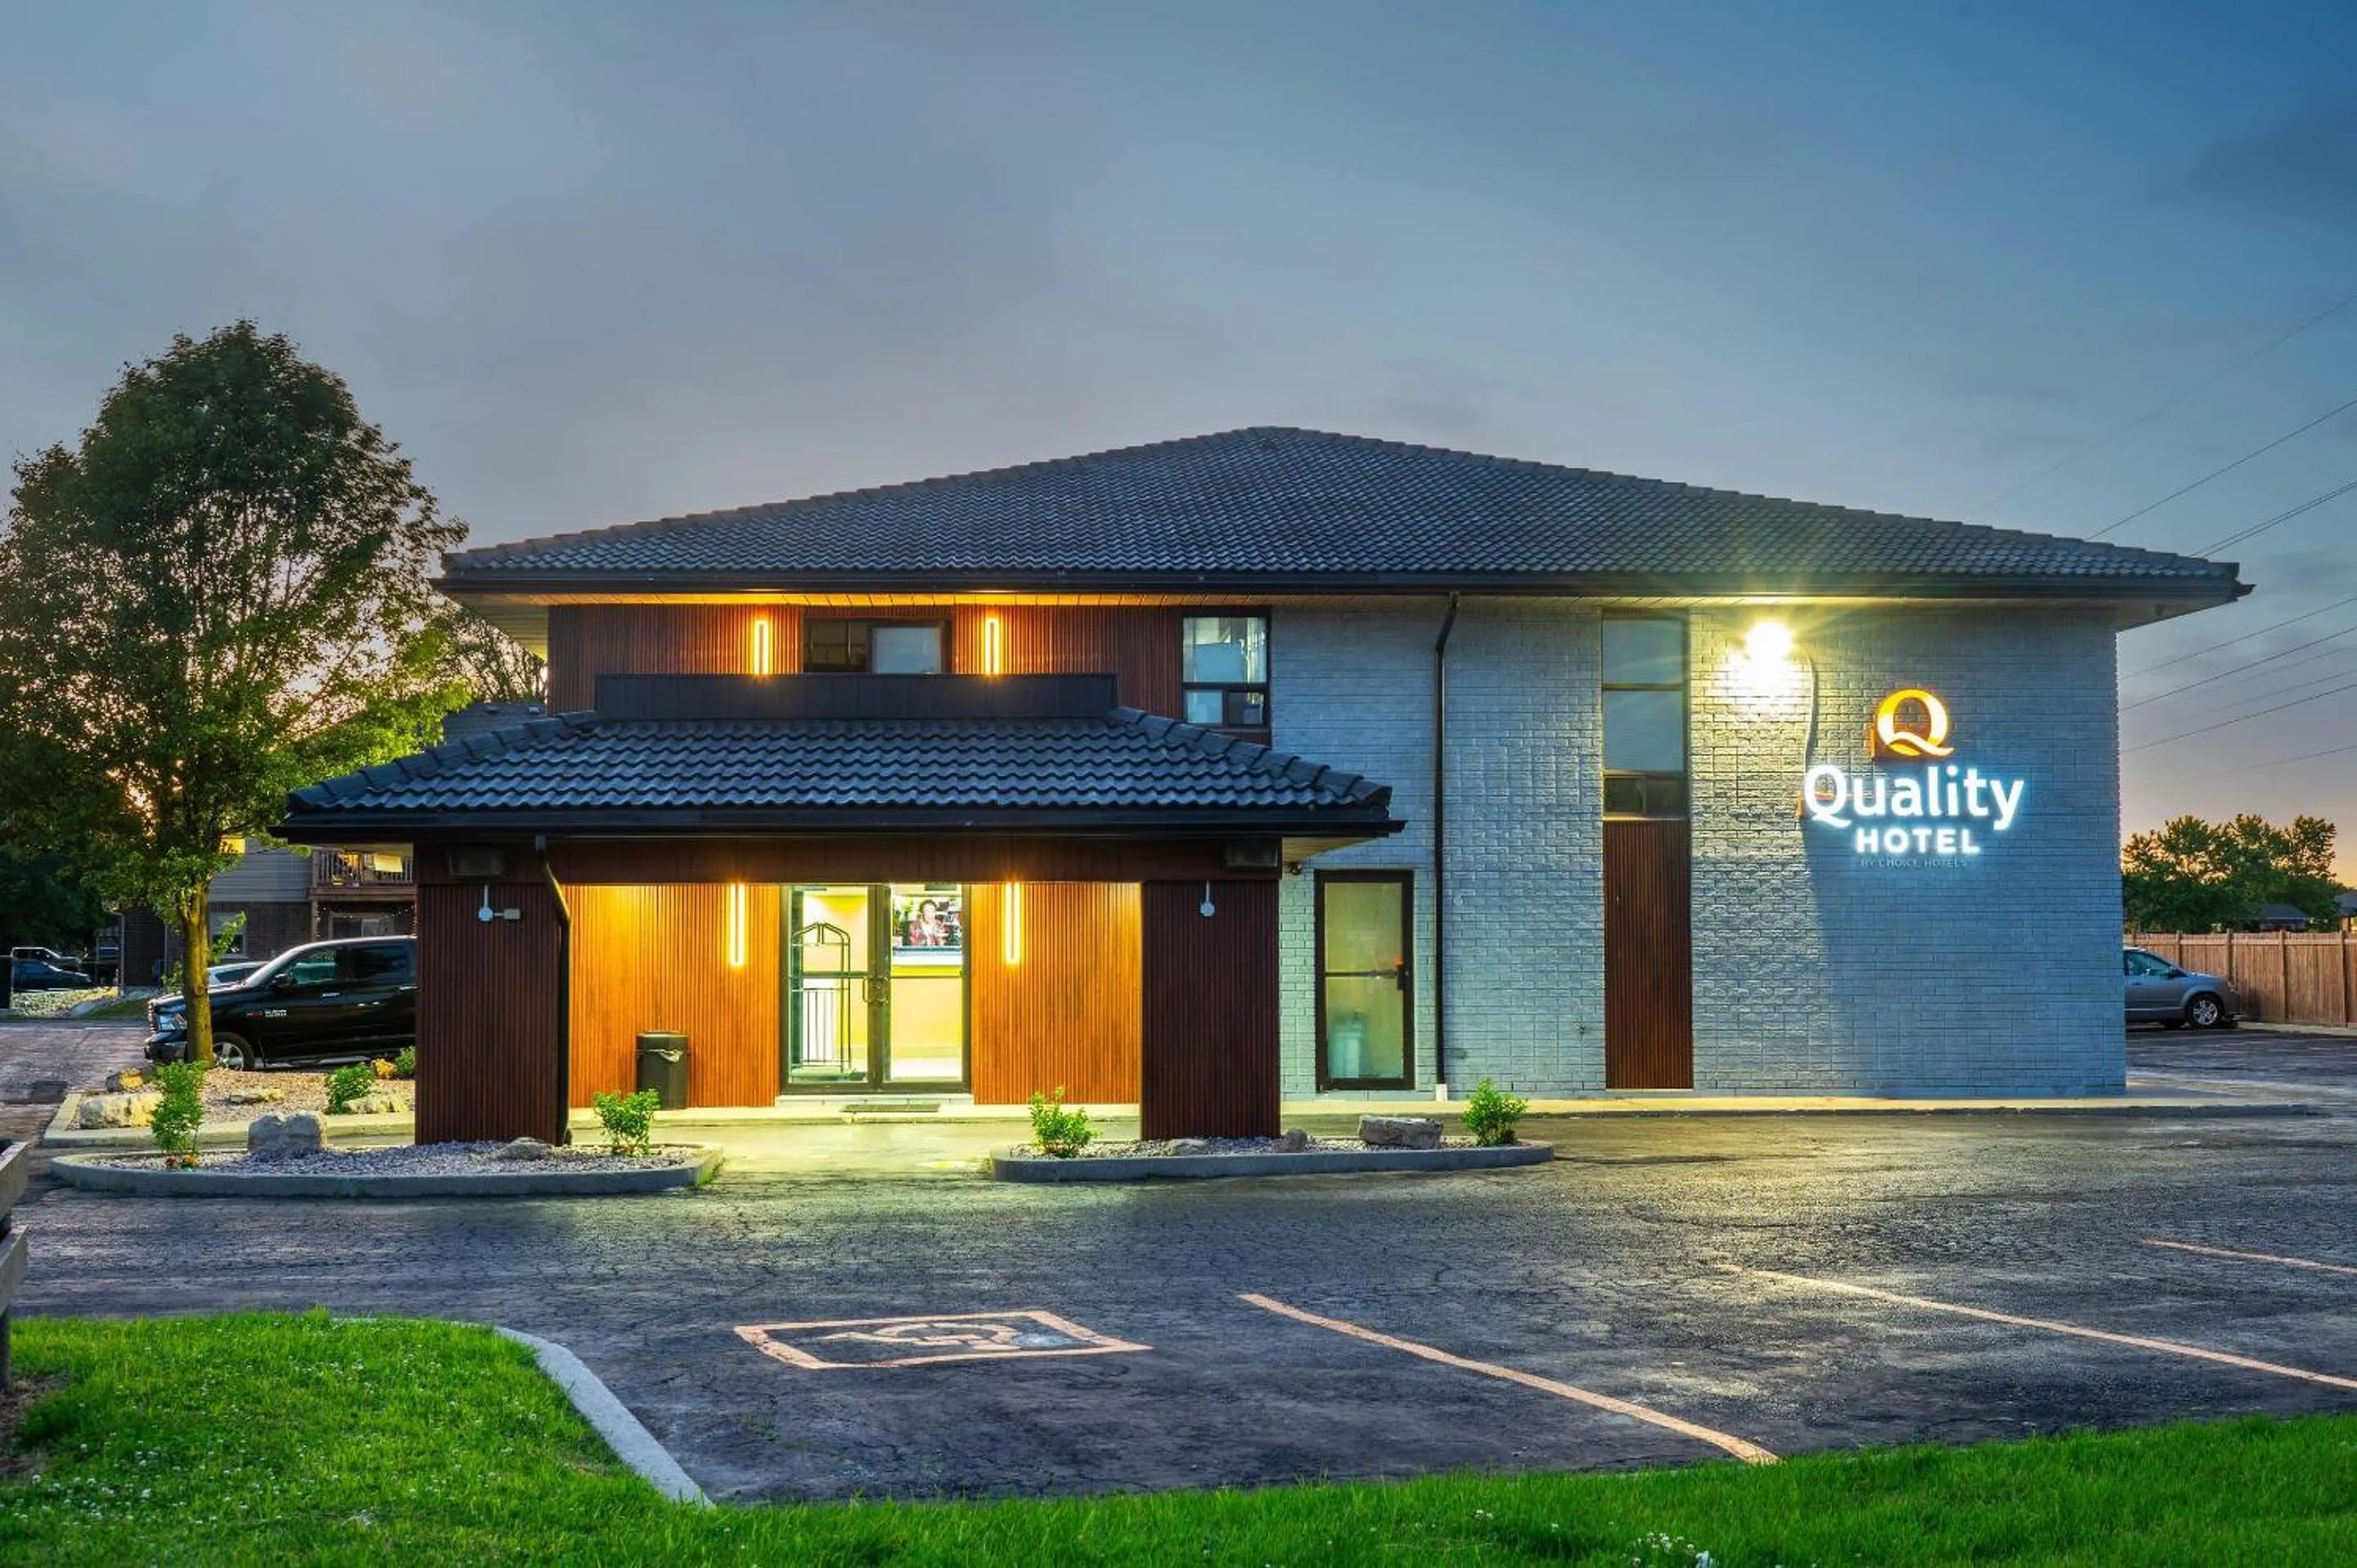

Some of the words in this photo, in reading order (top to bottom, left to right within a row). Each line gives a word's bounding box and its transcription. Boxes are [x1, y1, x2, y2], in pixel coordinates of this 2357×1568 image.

[1877, 689, 1954, 756] Q
[1804, 764, 2025, 831] Quality
[1855, 828, 1981, 854] HOTEL
